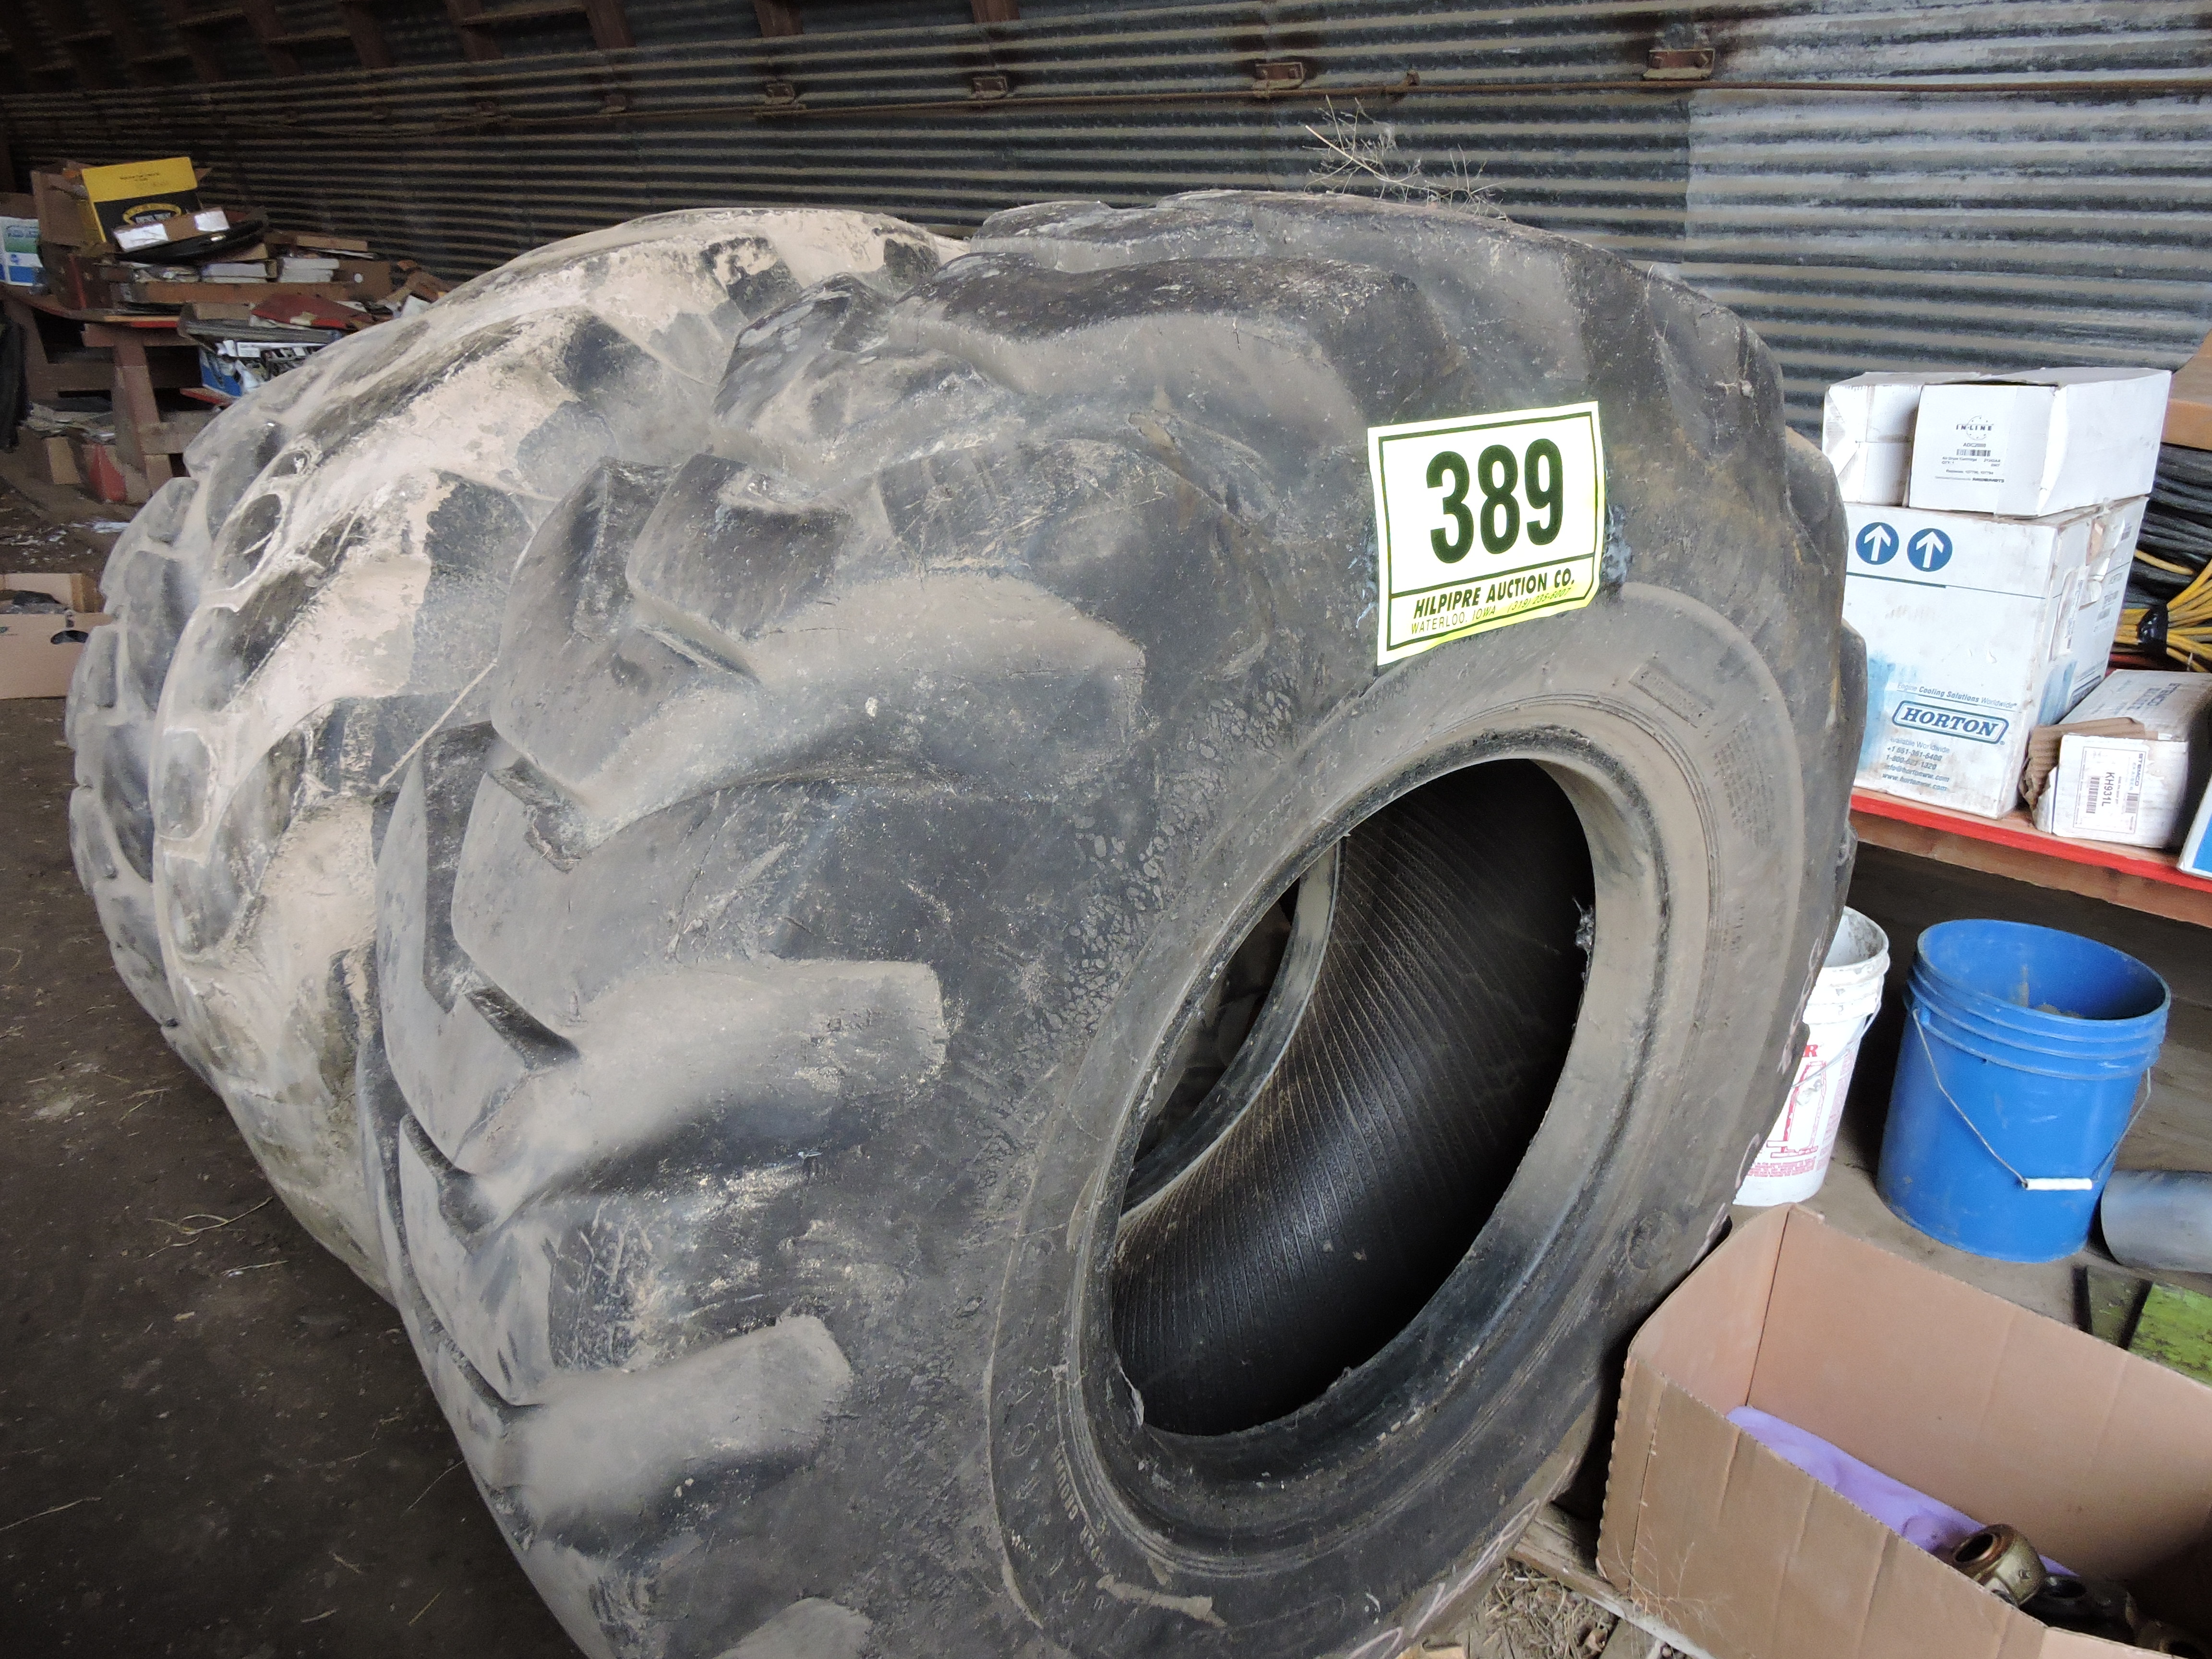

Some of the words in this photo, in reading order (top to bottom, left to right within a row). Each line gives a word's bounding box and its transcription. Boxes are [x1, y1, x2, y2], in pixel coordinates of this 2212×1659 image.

[1426, 438, 1563, 564] 389
[1413, 587, 1481, 619] HILPIPRE
[1486, 572, 1548, 603] AUCTION
[1554, 568, 1575, 589] CO.
[1472, 605, 1496, 621] IOWA
[1507, 598, 1531, 613] (319)
[1532, 588, 1571, 605] 235-6007
[1898, 683, 1917, 692] Engine
[1919, 686, 1945, 697] Cooling
[1947, 691, 1980, 703] Solutions
[1901, 708, 1999, 736] HORTON
[2135, 753, 2143, 786] STEMCO
[2102, 772, 2115, 807] KH931L
